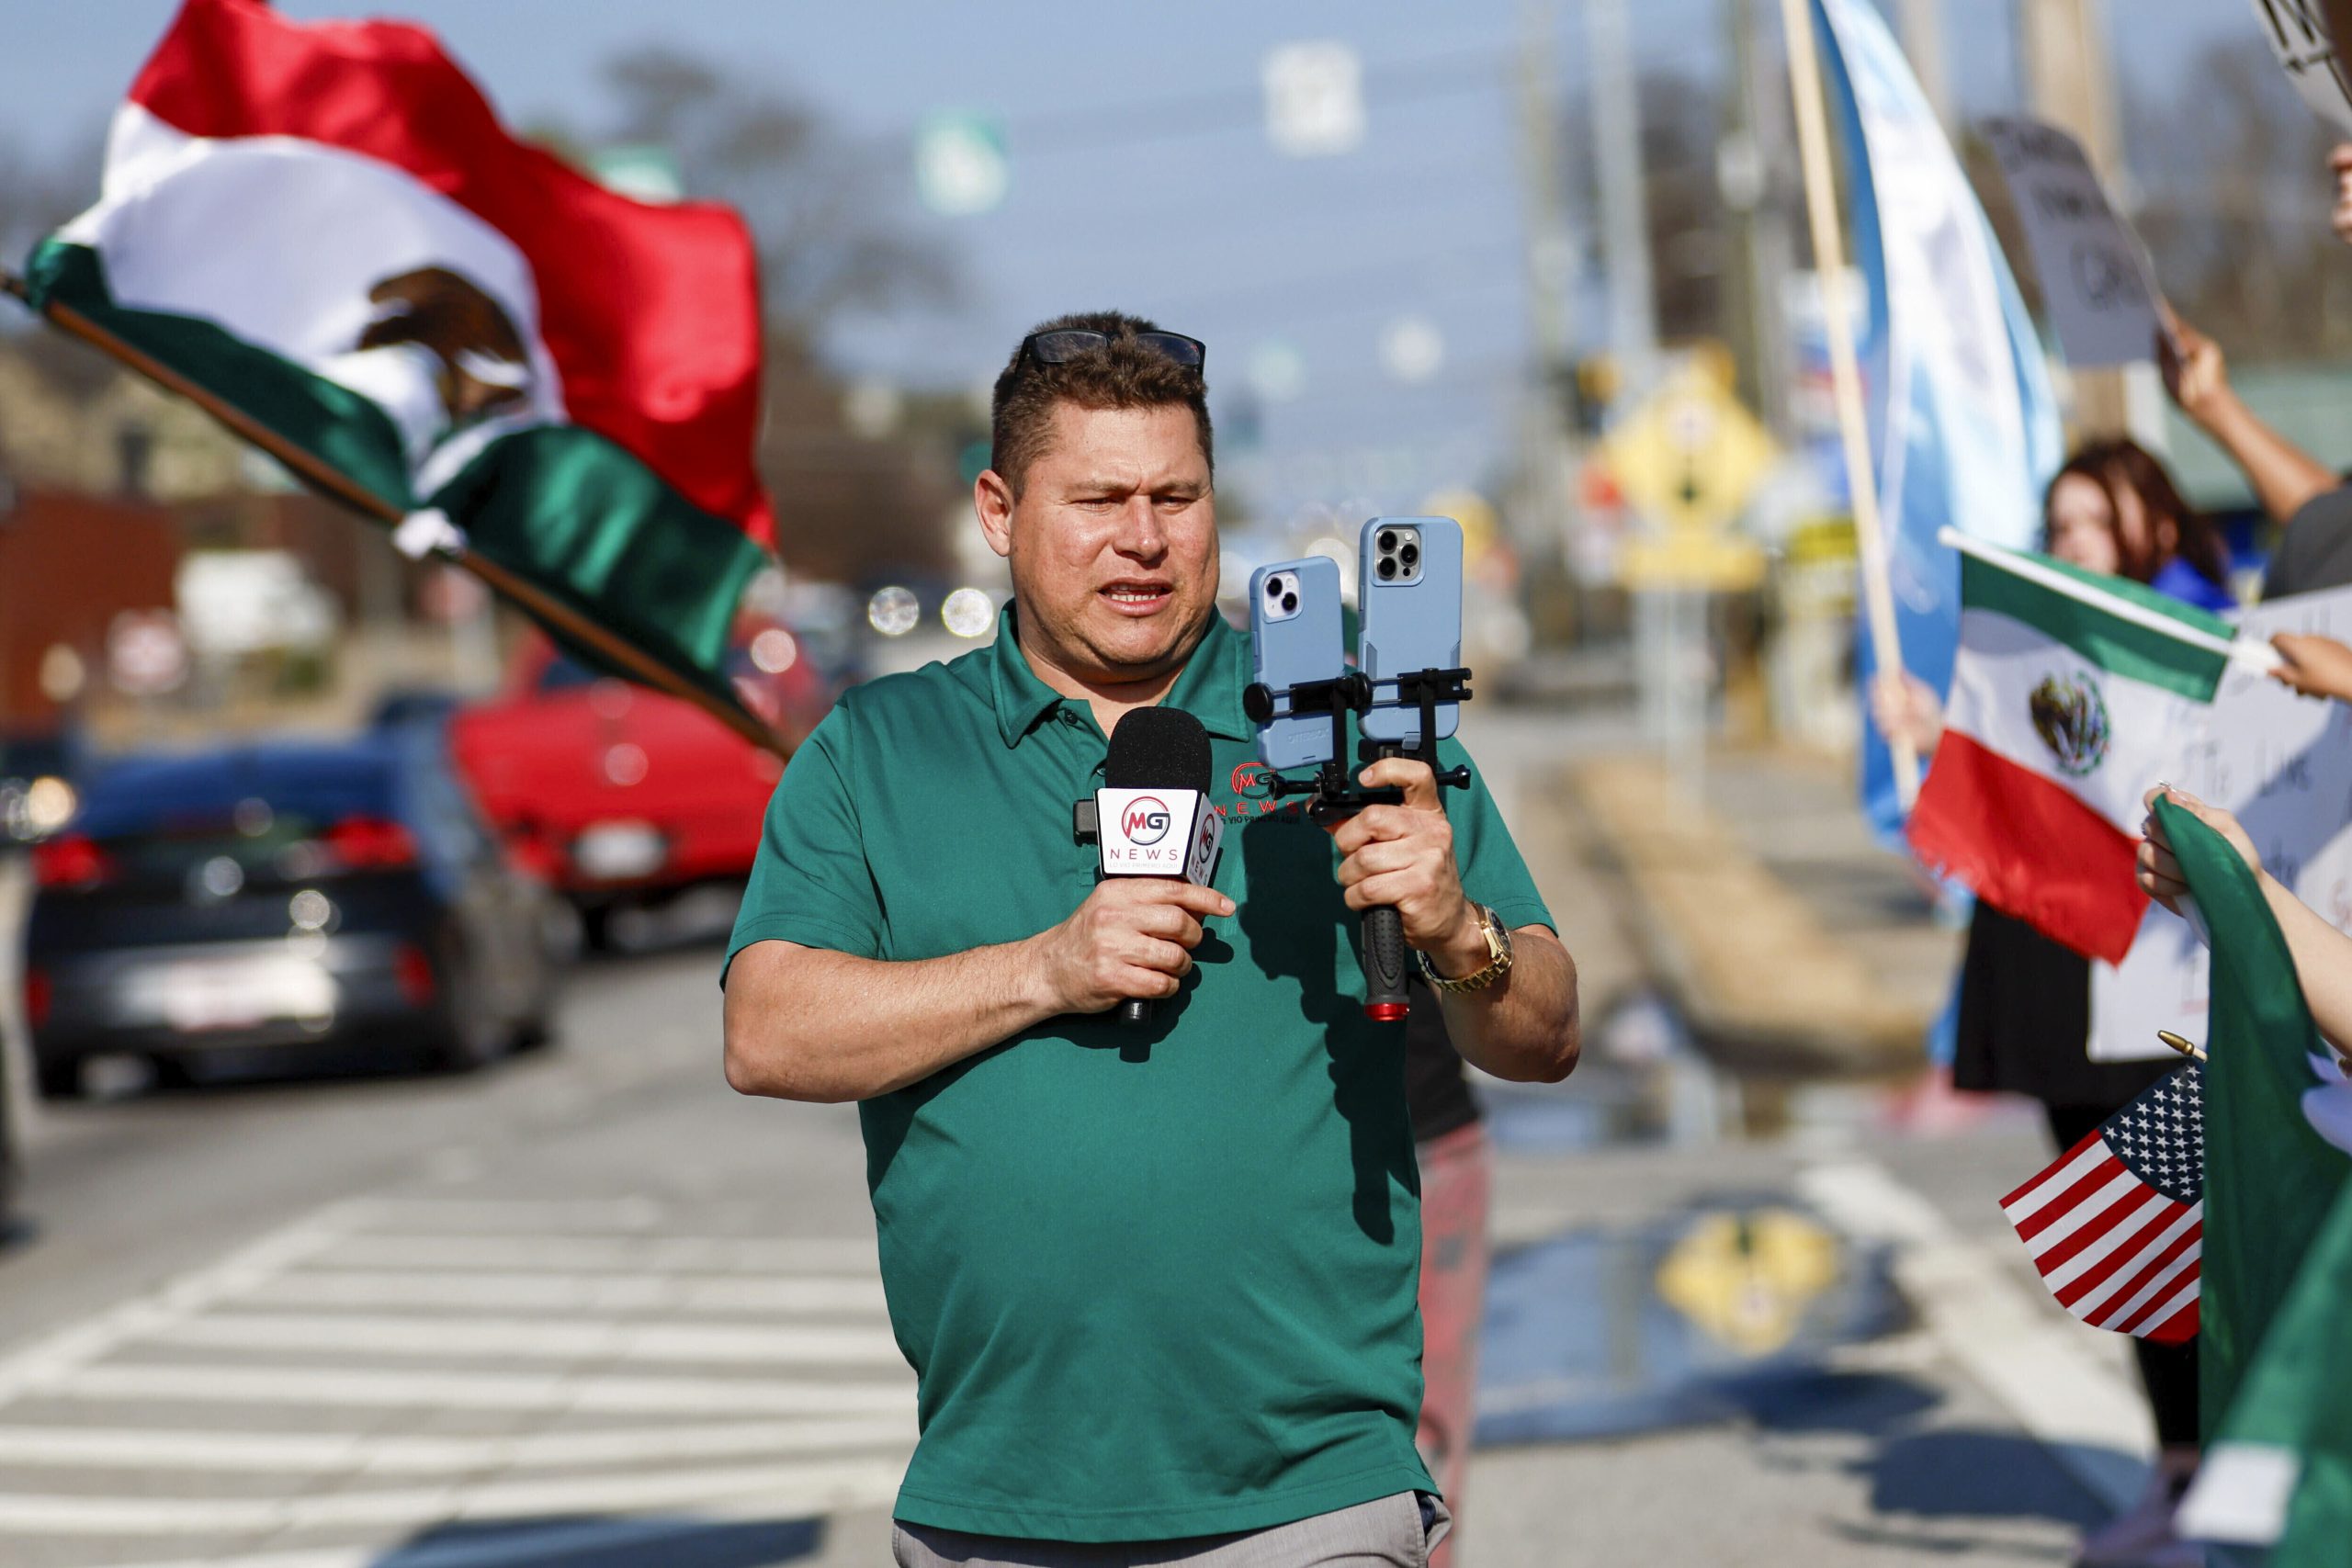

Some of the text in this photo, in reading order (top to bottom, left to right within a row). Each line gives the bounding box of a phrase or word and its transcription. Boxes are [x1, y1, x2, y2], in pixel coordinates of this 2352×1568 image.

[1214, 800, 1298, 817] NEWS
[1110, 848, 1178, 861] NEWS
[1192, 854, 1208, 886] NEWS
